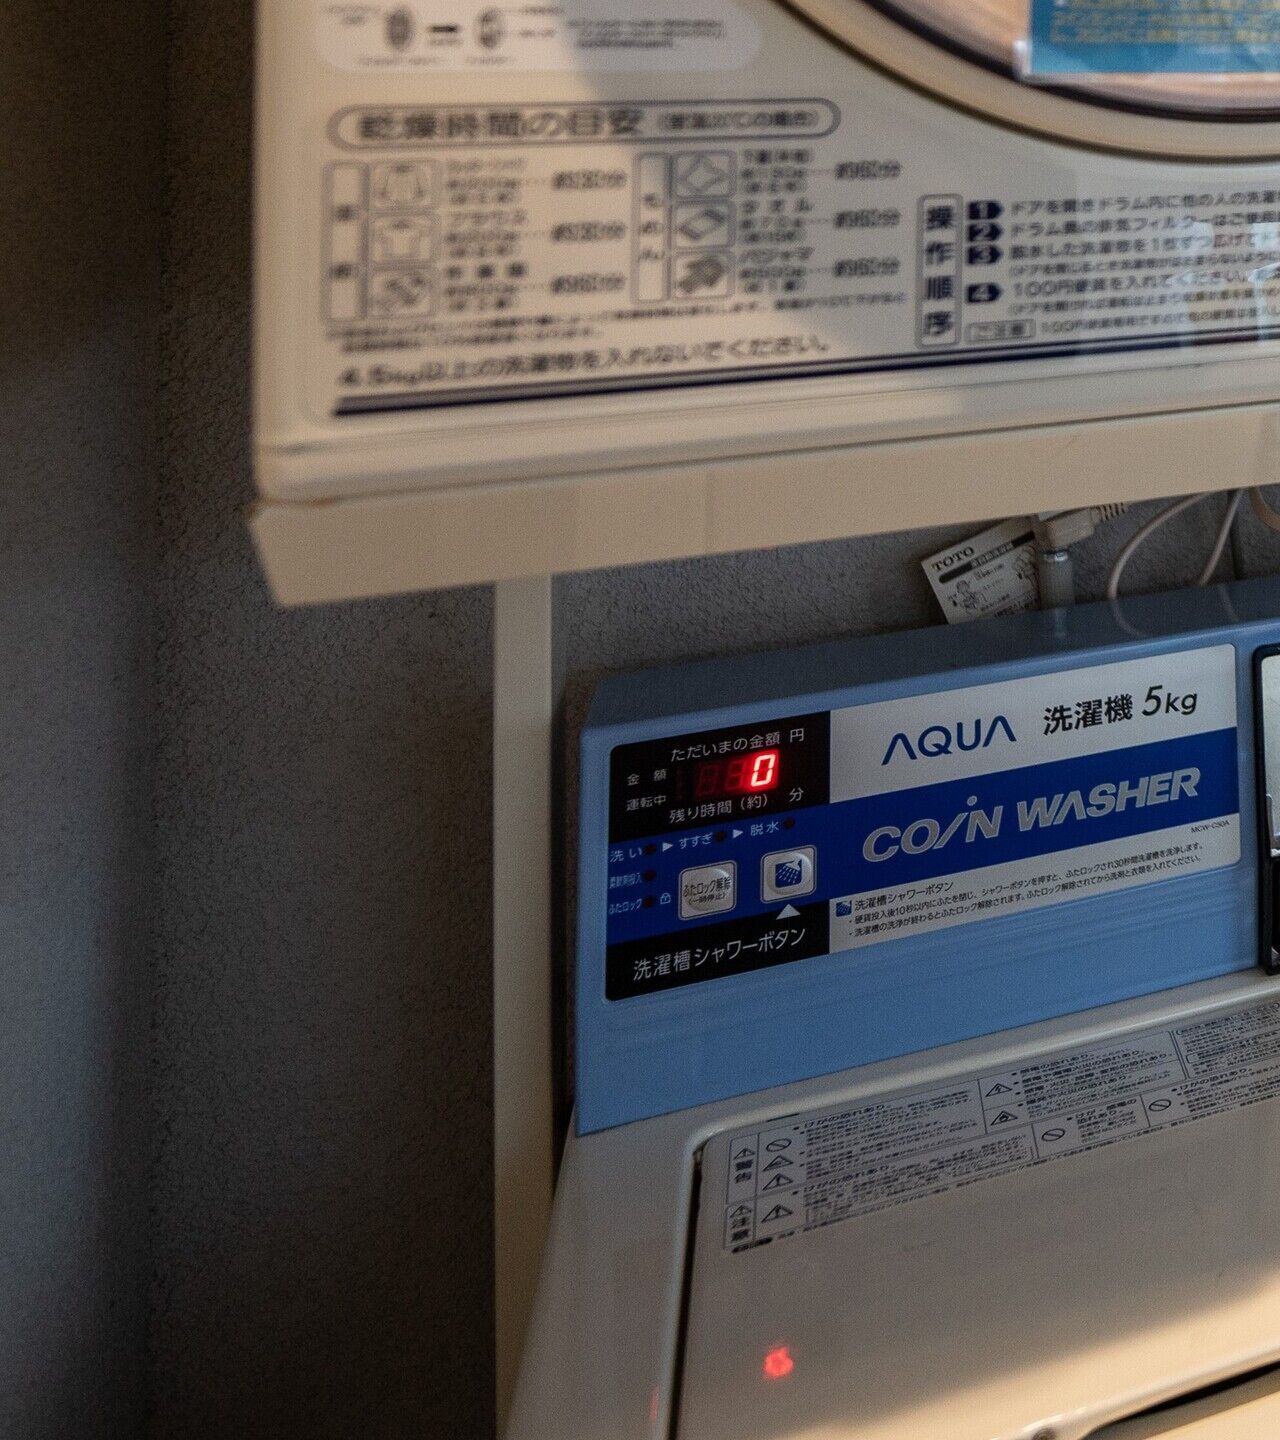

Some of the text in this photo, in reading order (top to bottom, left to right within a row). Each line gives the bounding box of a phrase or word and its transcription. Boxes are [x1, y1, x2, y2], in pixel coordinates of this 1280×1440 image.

[931, 546, 975, 572] TOTO
[881, 684, 1199, 766] AQUA 洗濯機 5kg
[671, 728, 805, 763] ただいまの金額 円
[751, 753, 776, 788] 0
[626, 794, 667, 811] 運転中
[789, 787, 804, 802] 分
[1017, 767, 1201, 833] WASHER
[679, 832, 714, 850] すすぎ
[750, 821, 780, 837] 脱水
[854, 881, 954, 912] 洗濯槽シャワーボタン
[633, 927, 806, 982] 洗濯槽シャワーボタン
